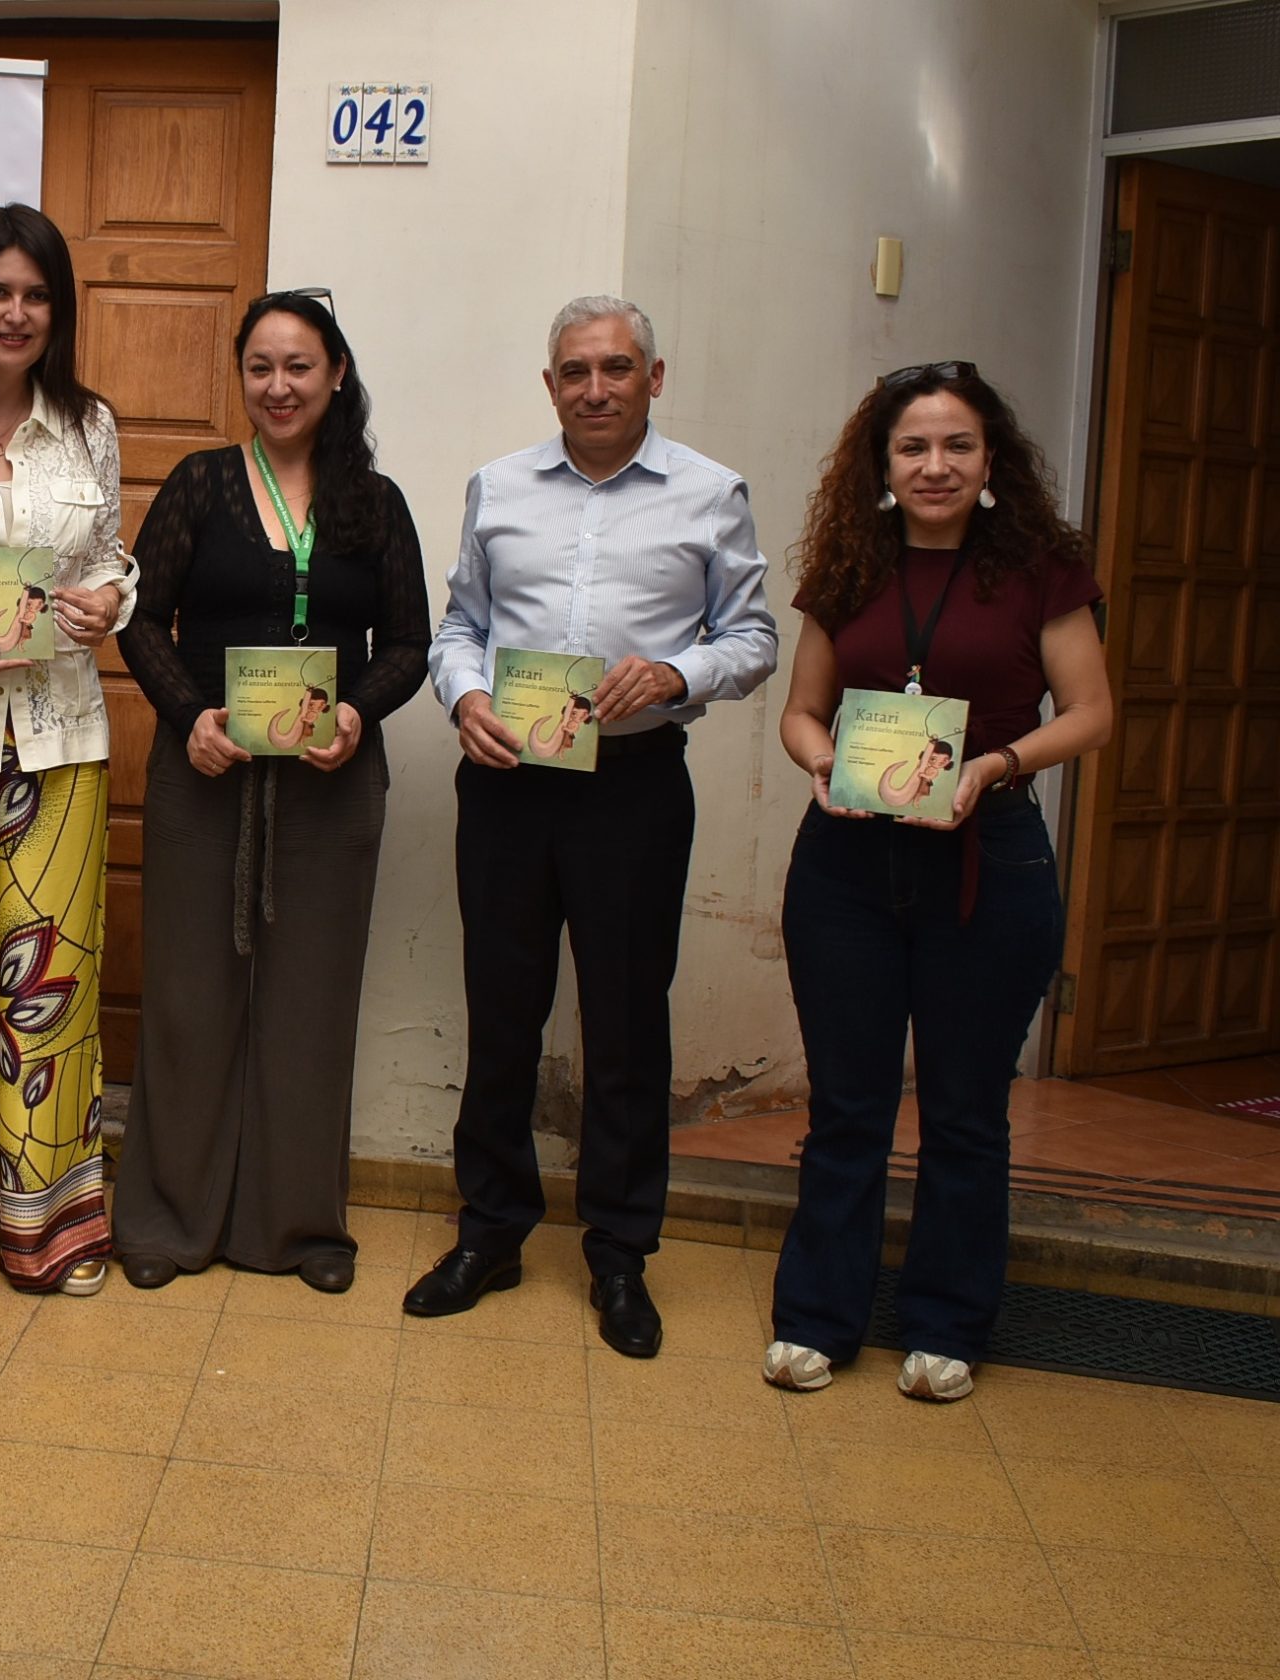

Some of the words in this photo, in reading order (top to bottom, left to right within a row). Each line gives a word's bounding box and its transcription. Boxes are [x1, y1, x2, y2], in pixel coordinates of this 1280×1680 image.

[332, 97, 427, 145] 042
[238, 666, 277, 678] Katari
[506, 666, 543, 681] Katari
[855, 708, 900, 725] Katari
